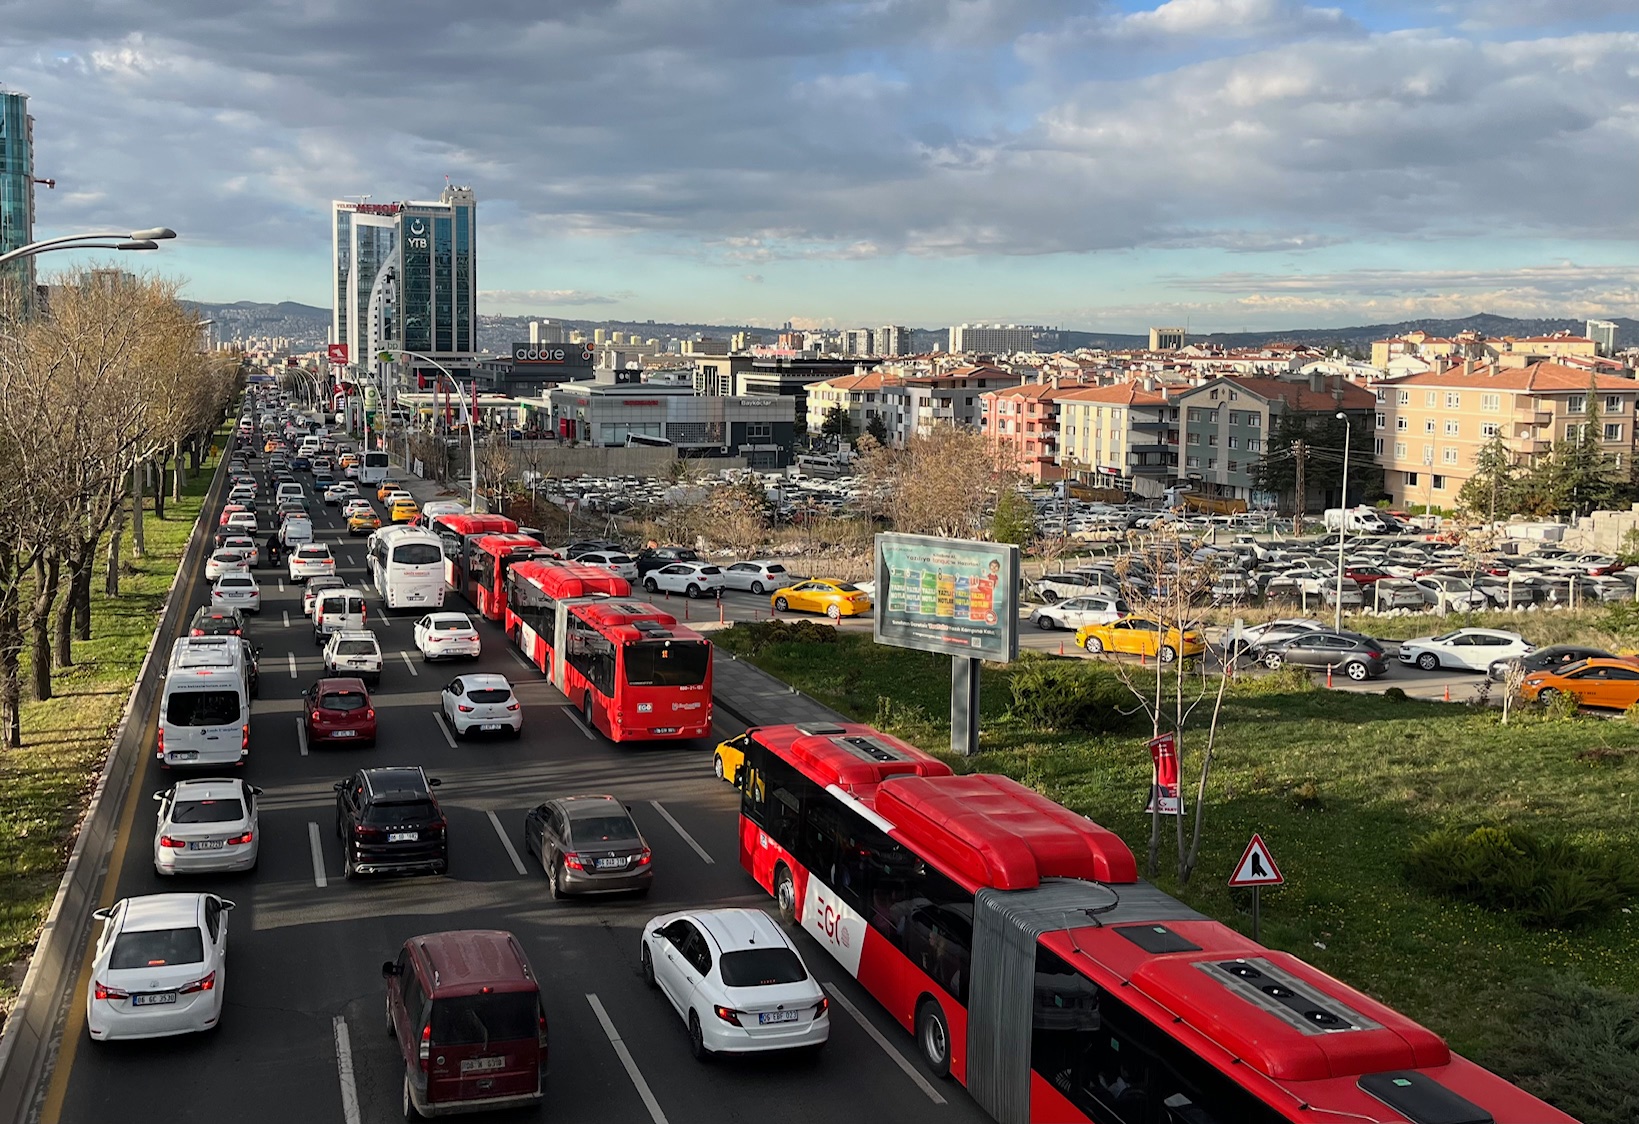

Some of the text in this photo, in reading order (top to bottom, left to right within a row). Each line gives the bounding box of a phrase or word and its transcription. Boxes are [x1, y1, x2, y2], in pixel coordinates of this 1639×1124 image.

[407, 237, 428, 249] YTB
[387, 341, 399, 350] bp
[515, 346, 565, 361] adore
